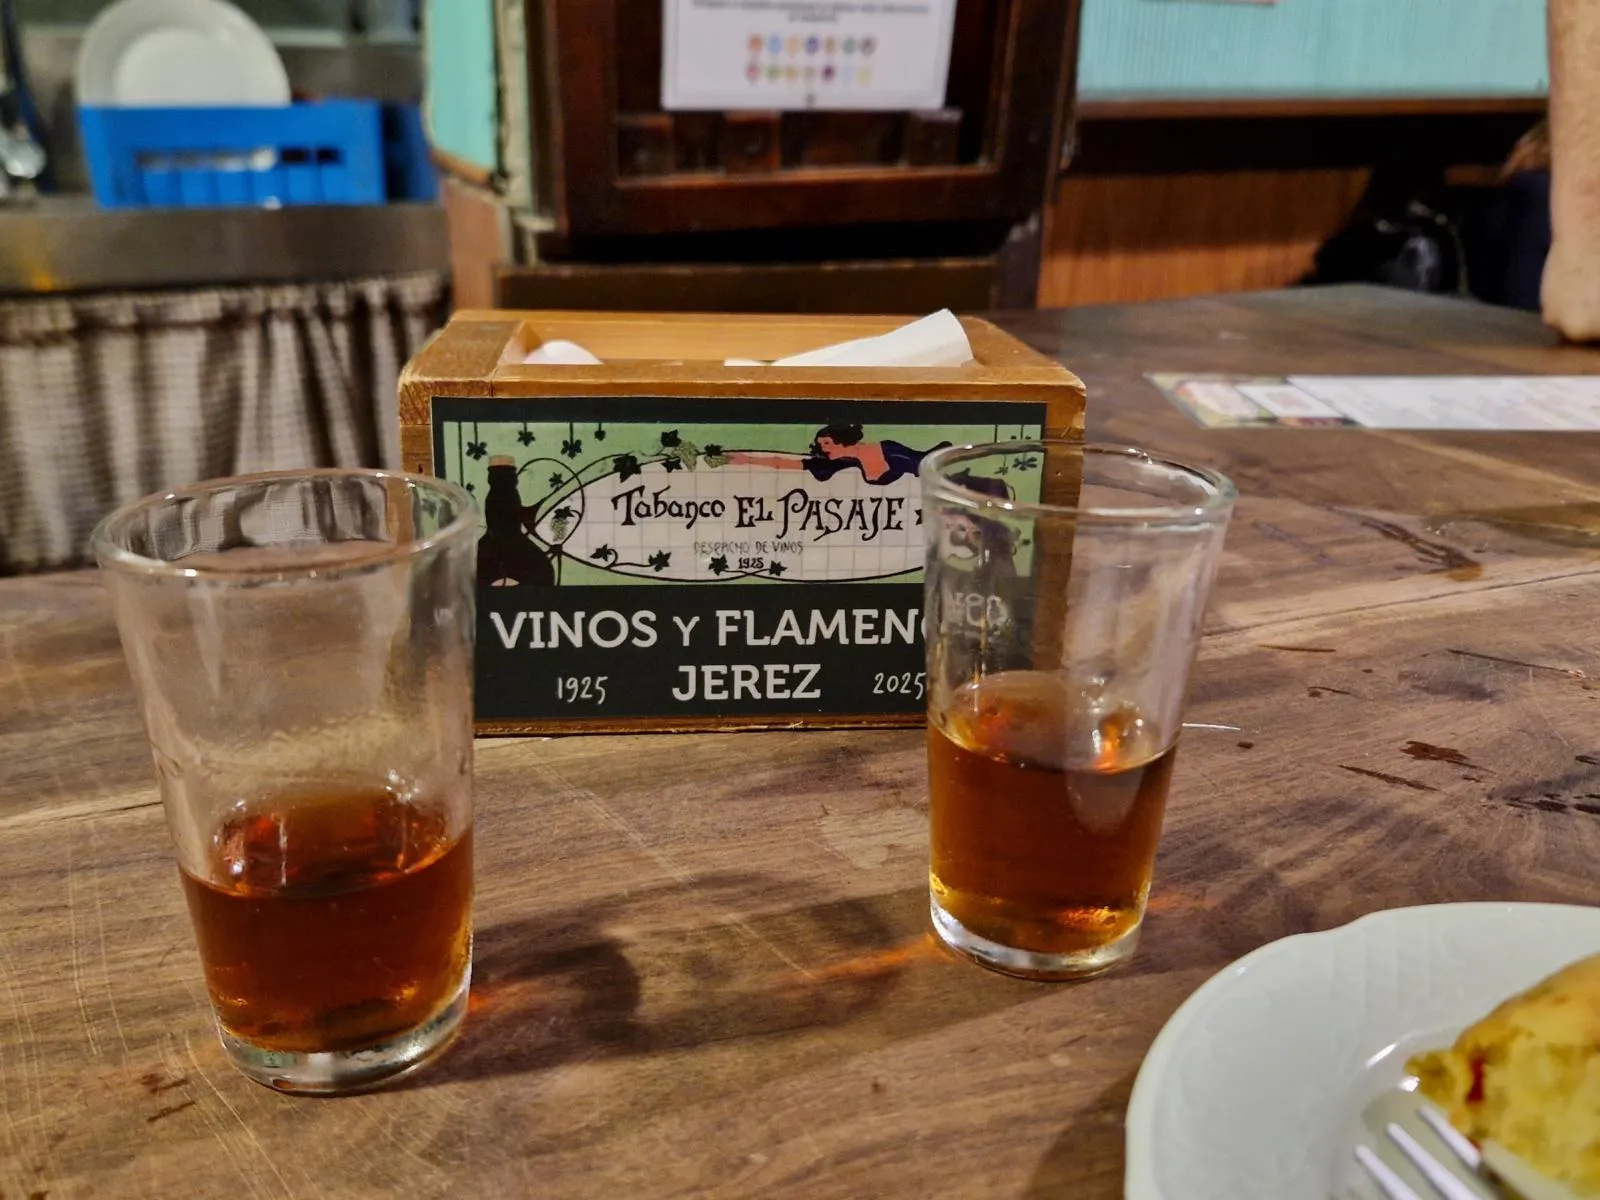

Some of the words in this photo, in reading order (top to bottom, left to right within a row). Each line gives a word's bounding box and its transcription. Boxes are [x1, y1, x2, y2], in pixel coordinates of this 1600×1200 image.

[611, 485, 726, 530] Tabanco
[776, 488, 905, 541] PASAJE
[755, 541, 768, 554] DE
[772, 541, 803, 555] VINOS
[738, 557, 764, 569] 1925
[490, 610, 658, 649] VINOS
[672, 616, 700, 647] Y
[556, 676, 609, 704] 1925
[672, 664, 821, 701] JEREZ
[872, 672, 927, 700] 2025
